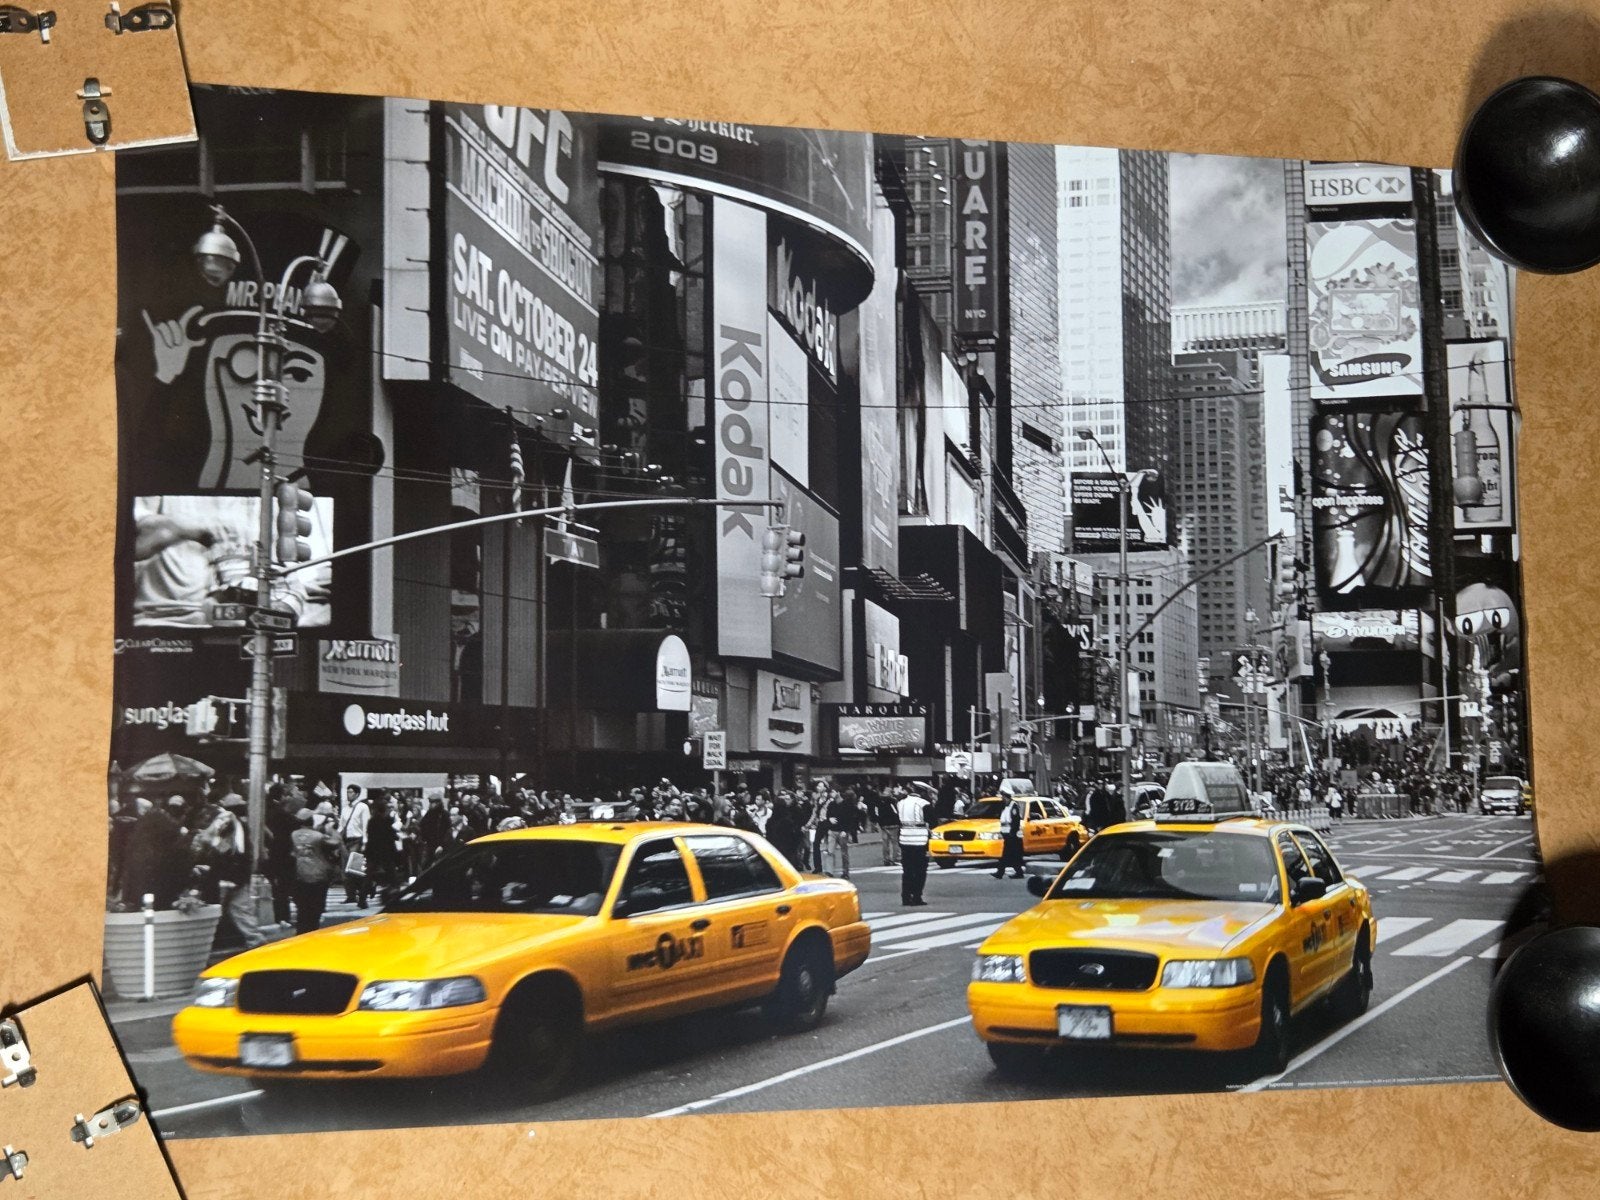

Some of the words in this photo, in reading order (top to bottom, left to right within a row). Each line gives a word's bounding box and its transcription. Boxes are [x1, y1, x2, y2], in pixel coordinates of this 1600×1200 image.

[630, 131, 718, 165] 2009
[1310, 177, 1372, 197] HSBC
[460, 137, 532, 253] MACHIDA
[541, 217, 592, 304] SHOGUN
[961, 139, 989, 285] UARE
[226, 281, 258, 306] MR.
[454, 232, 494, 316] SAT.
[498, 269, 575, 374] OCTOBER
[578, 333, 599, 388] 24
[965, 309, 987, 319] NYC
[454, 296, 488, 346] LIVE
[491, 323, 512, 362] ON
[1329, 361, 1401, 377] SAMSUNG
[720, 324, 764, 541] Kodak
[325, 640, 396, 662] Marriott
[125, 701, 189, 730] sunglas
[367, 708, 426, 736] sunglass
[426, 709, 450, 731] hut
[838, 705, 928, 715] MARQUIS
